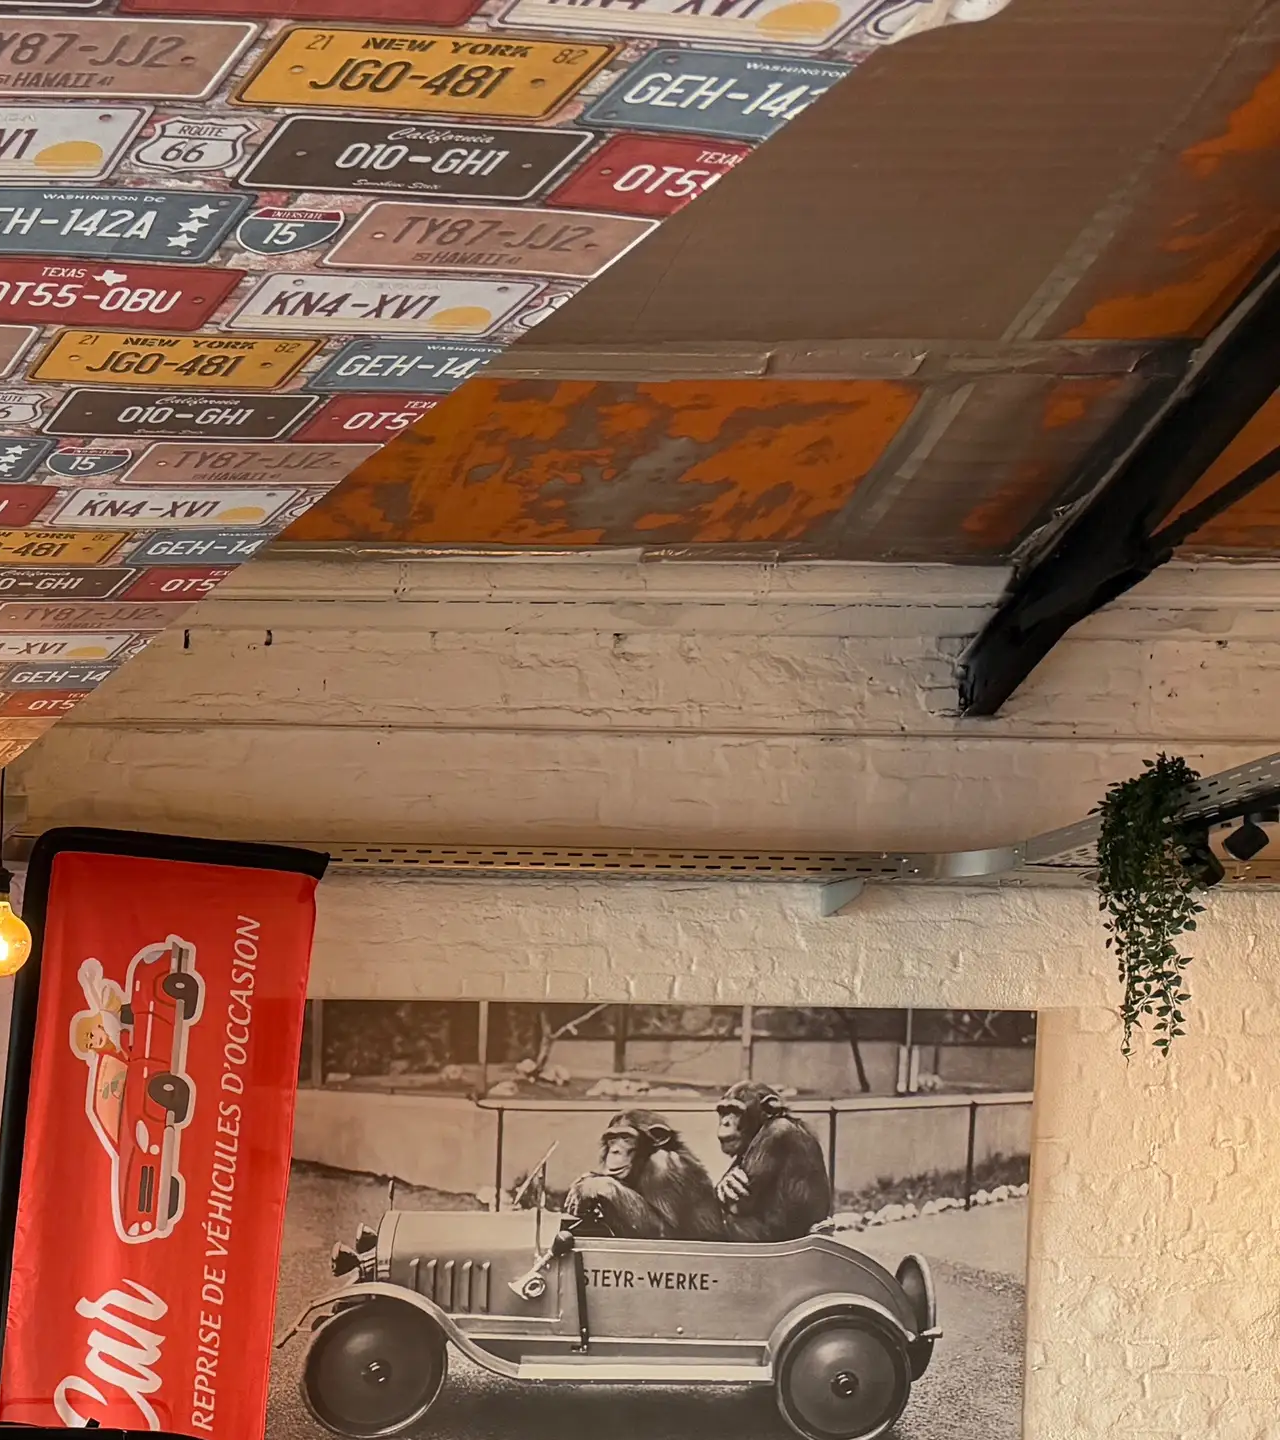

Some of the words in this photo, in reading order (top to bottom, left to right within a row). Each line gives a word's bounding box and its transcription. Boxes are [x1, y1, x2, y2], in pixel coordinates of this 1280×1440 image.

[361, 35, 437, 53] NEW
[446, 40, 531, 58] YORK
[553, 47, 589, 65] 82
[178, 124, 229, 139] ROUTE
[162, 140, 203, 164] 66
[140, 194, 166, 204] DC
[261, 222, 299, 247] 15
[41, 266, 86, 280] TEXAS
[202, 1101, 243, 1258] VÉHICULES
[201, 1262, 227, 1303] DE
[53, 1277, 169, 1431] Car
[192, 1310, 223, 1432] REPRISE
